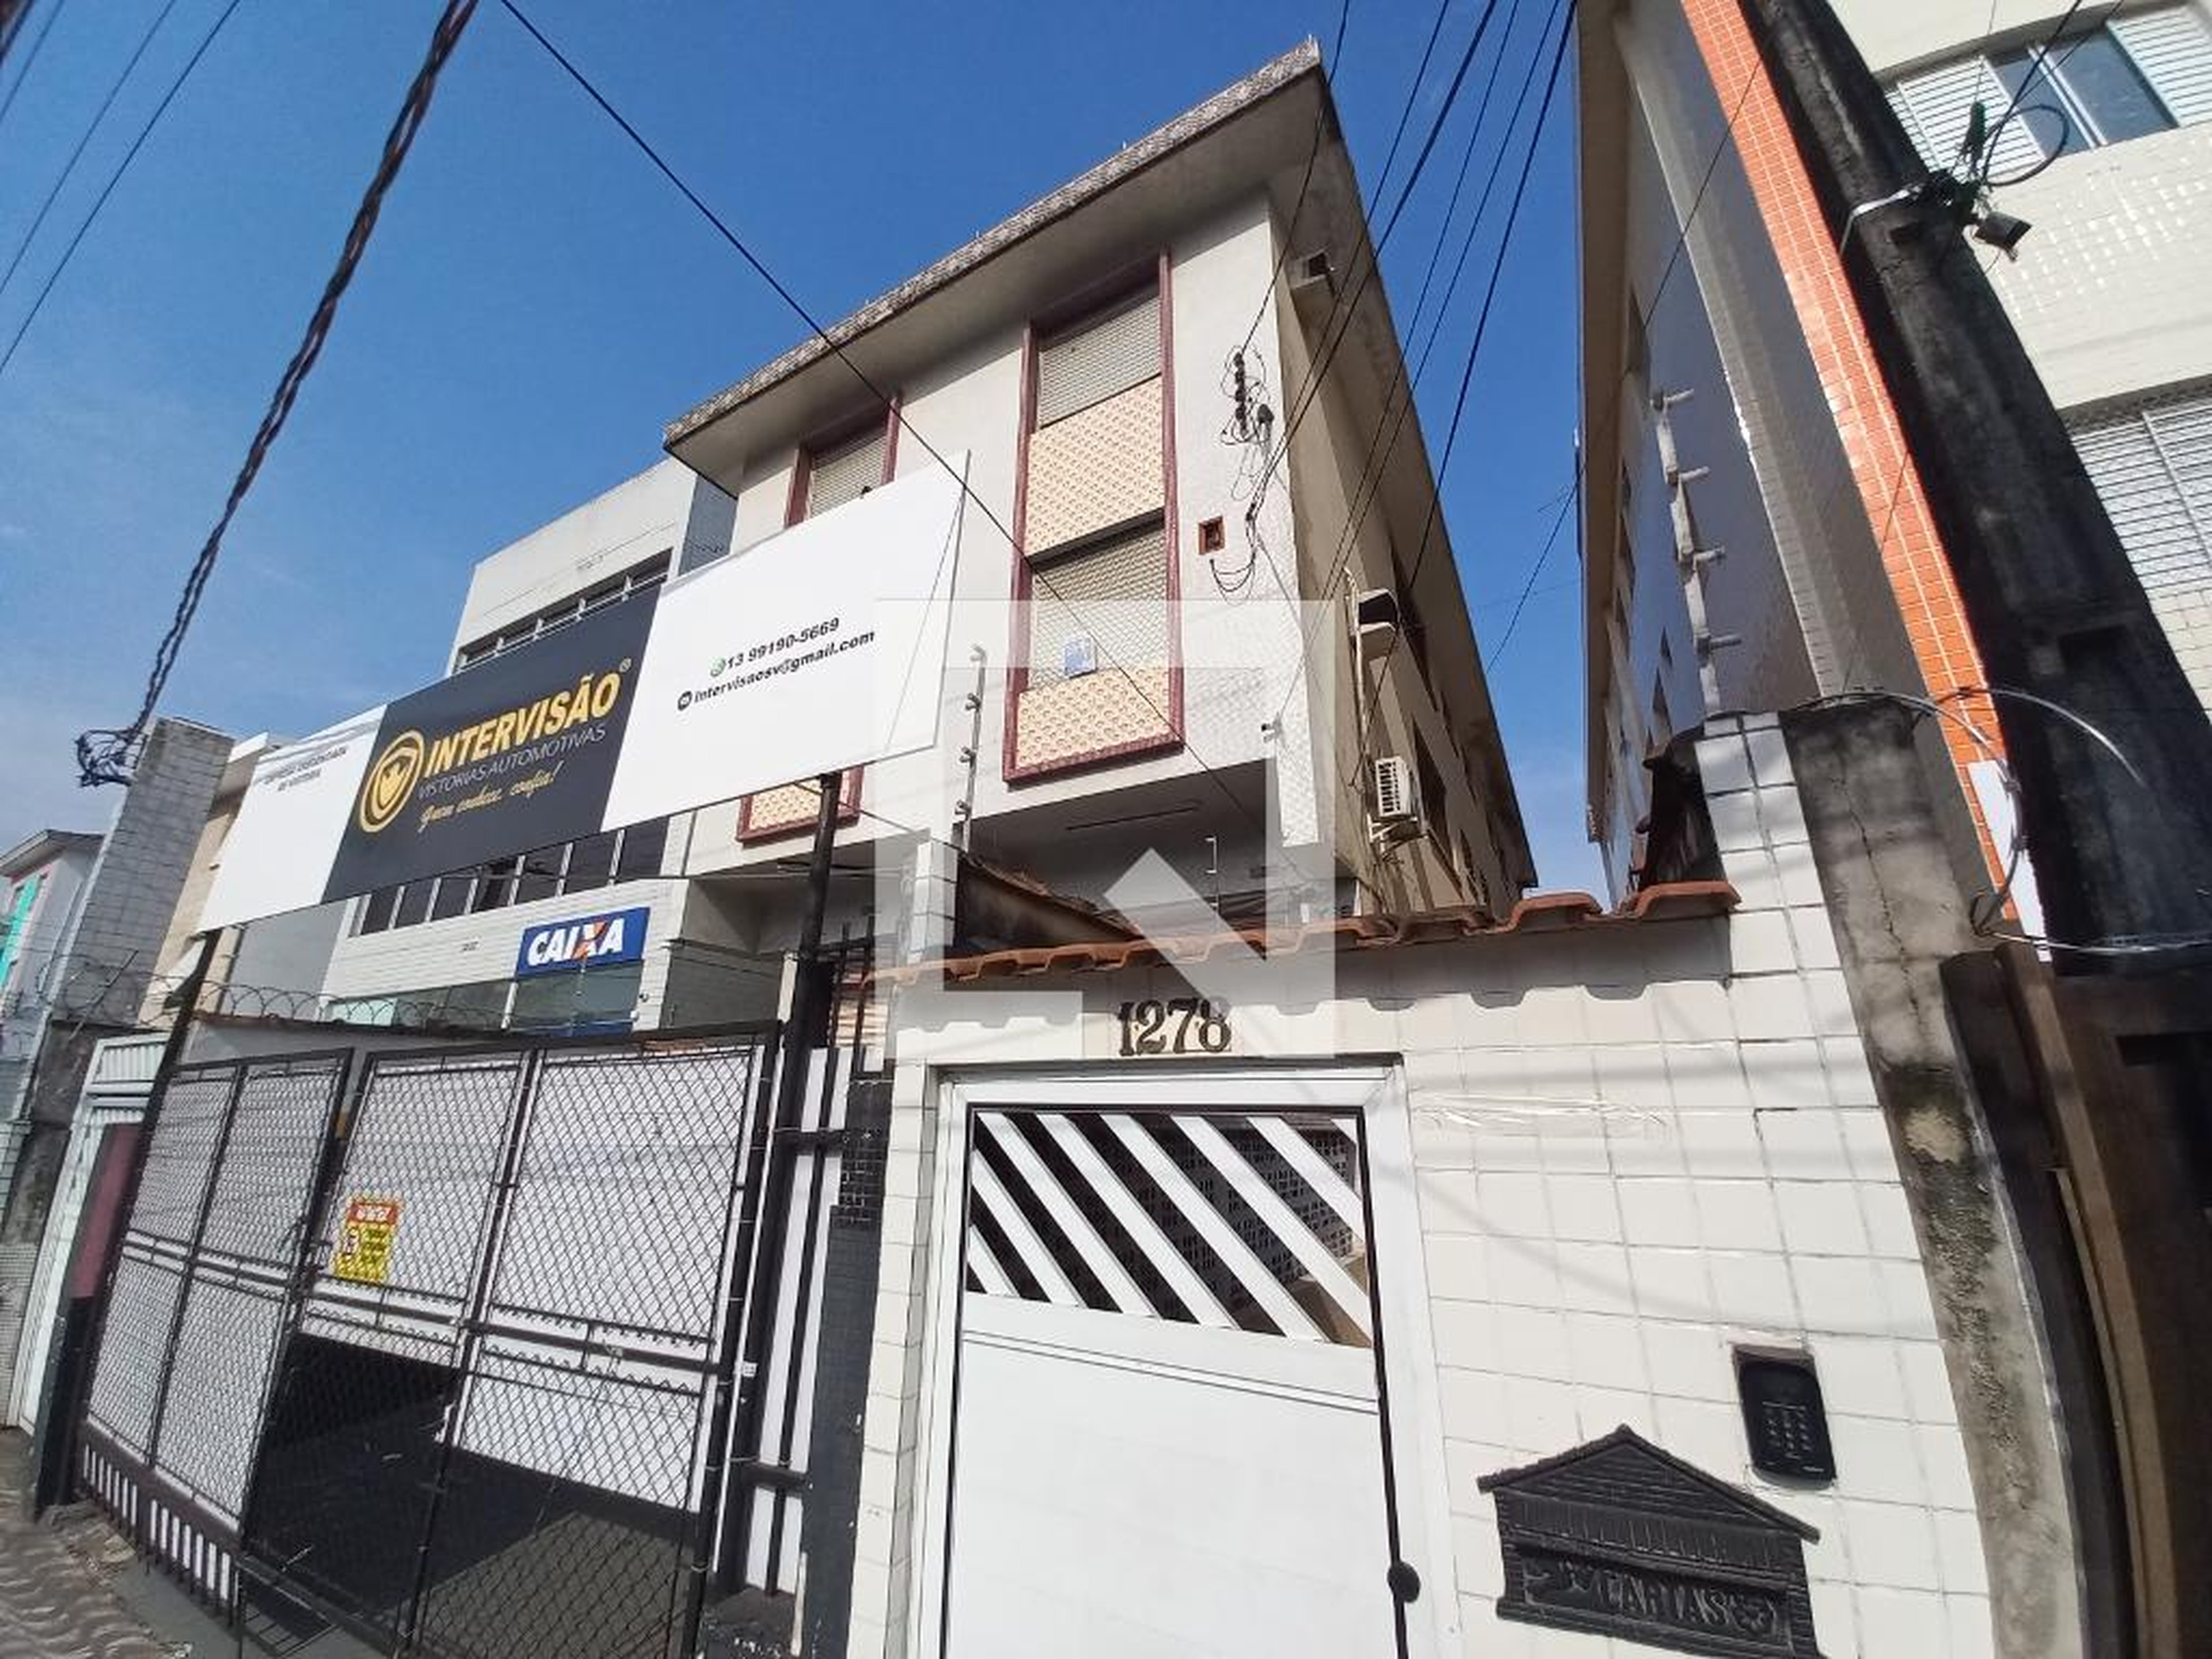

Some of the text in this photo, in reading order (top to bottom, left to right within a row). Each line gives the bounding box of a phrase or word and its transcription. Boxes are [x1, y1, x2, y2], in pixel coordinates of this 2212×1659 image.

[728, 652, 744, 669] 13
[423, 672, 621, 779] INTERVISÃO
[488, 724, 606, 775] AUTOMOTIVAS
[528, 918, 624, 967] CAIXA
